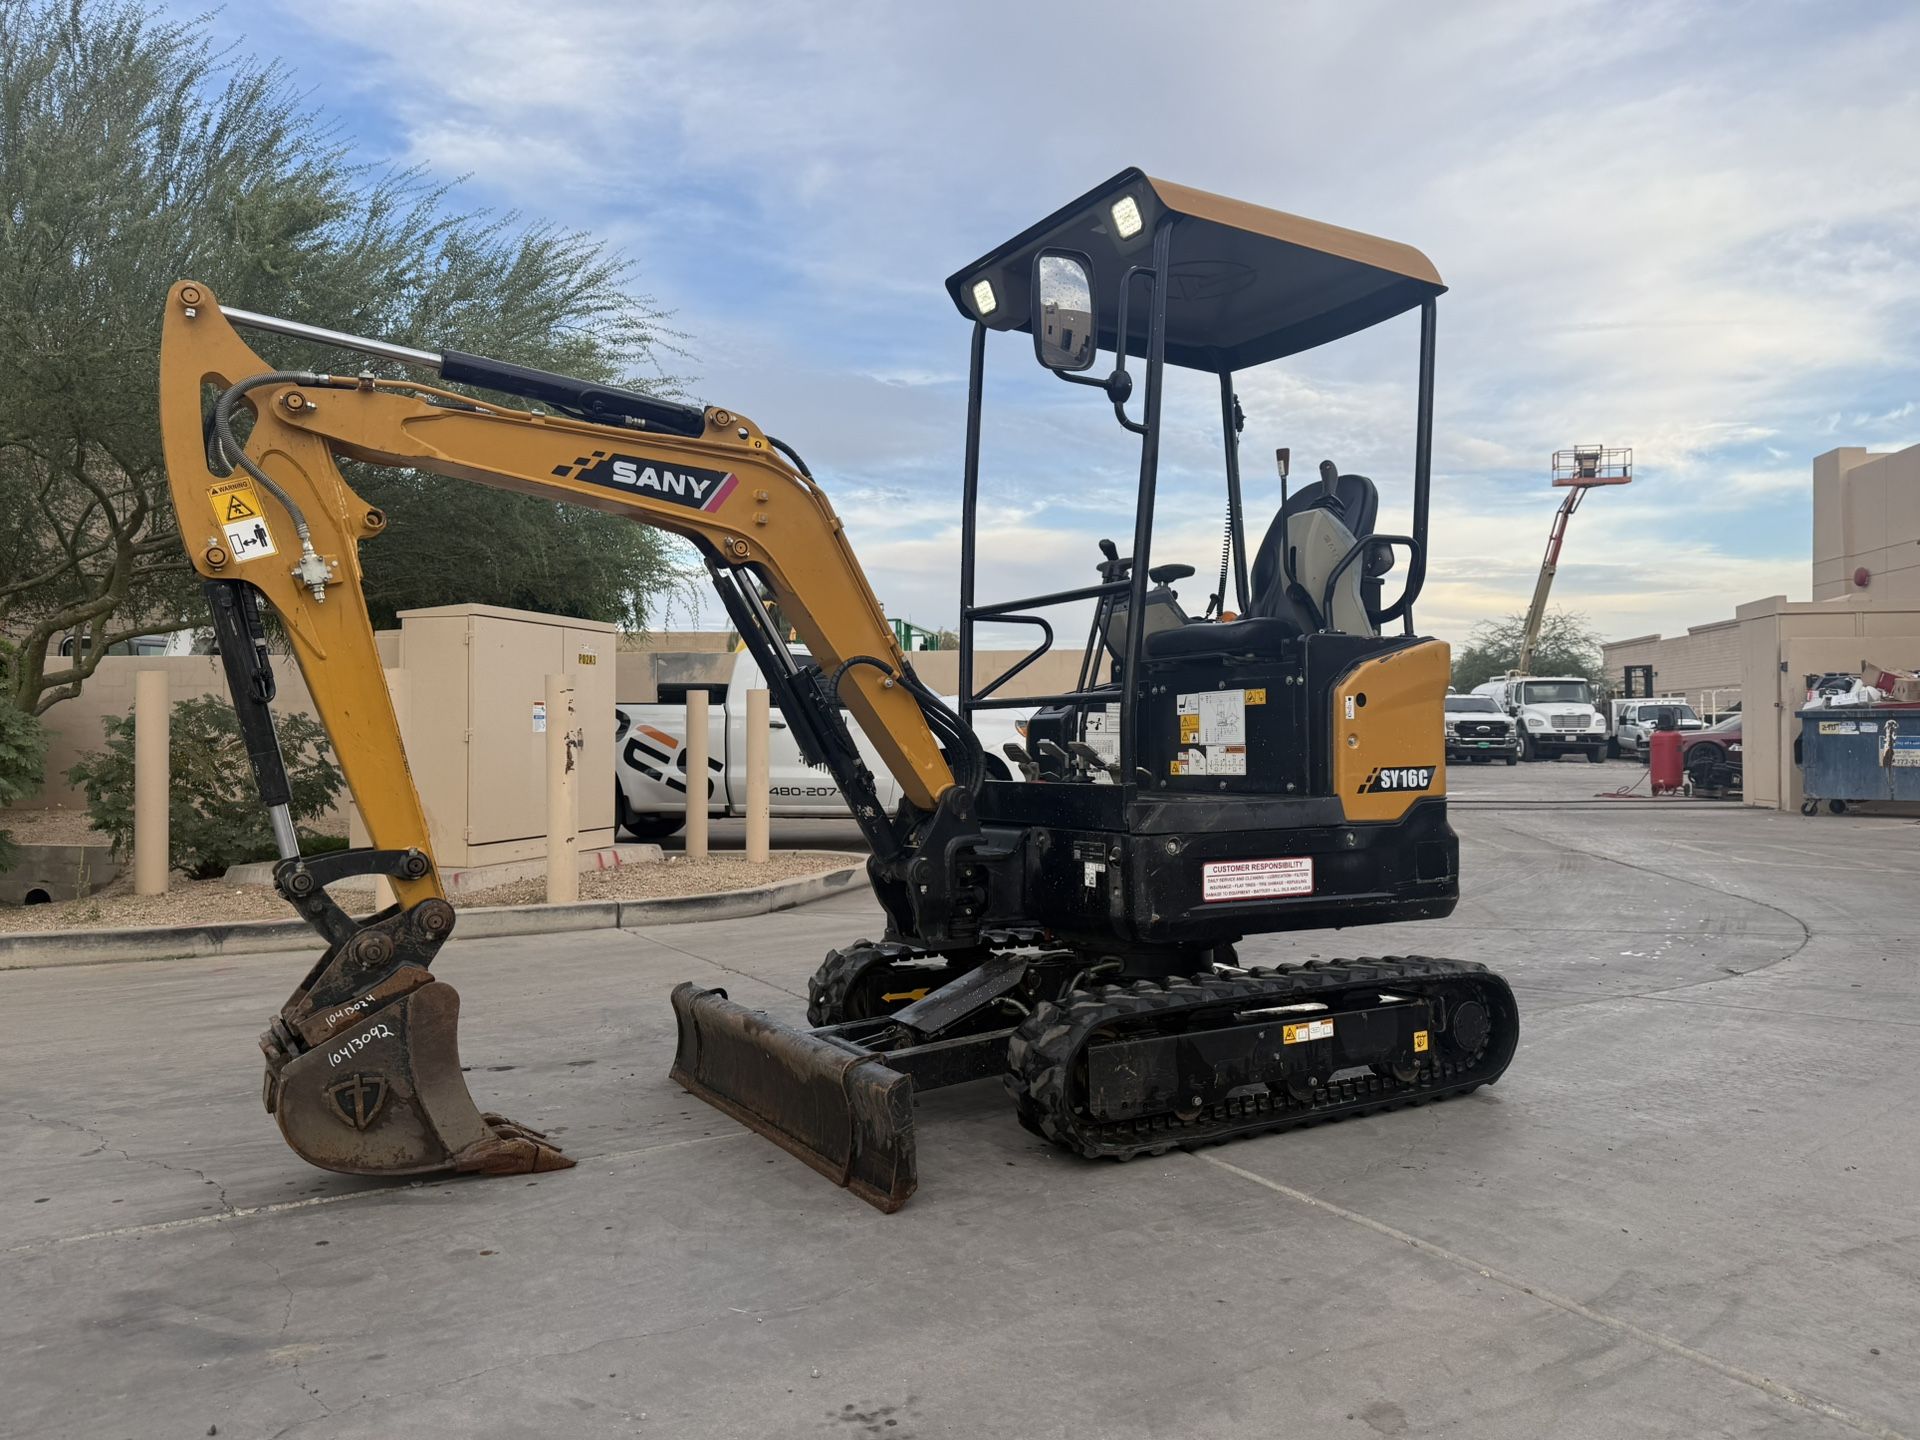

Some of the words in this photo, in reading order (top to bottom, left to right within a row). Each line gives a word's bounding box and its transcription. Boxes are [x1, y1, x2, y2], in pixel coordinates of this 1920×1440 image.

[218, 481, 248, 493] WARNING
[612, 460, 712, 500] SANY
[1380, 768, 1429, 789] SY16C
[1213, 863, 1250, 874] CUSTOMER
[1251, 860, 1304, 871] RESPONSIBILITY
[328, 1024, 395, 1068] 10413092
